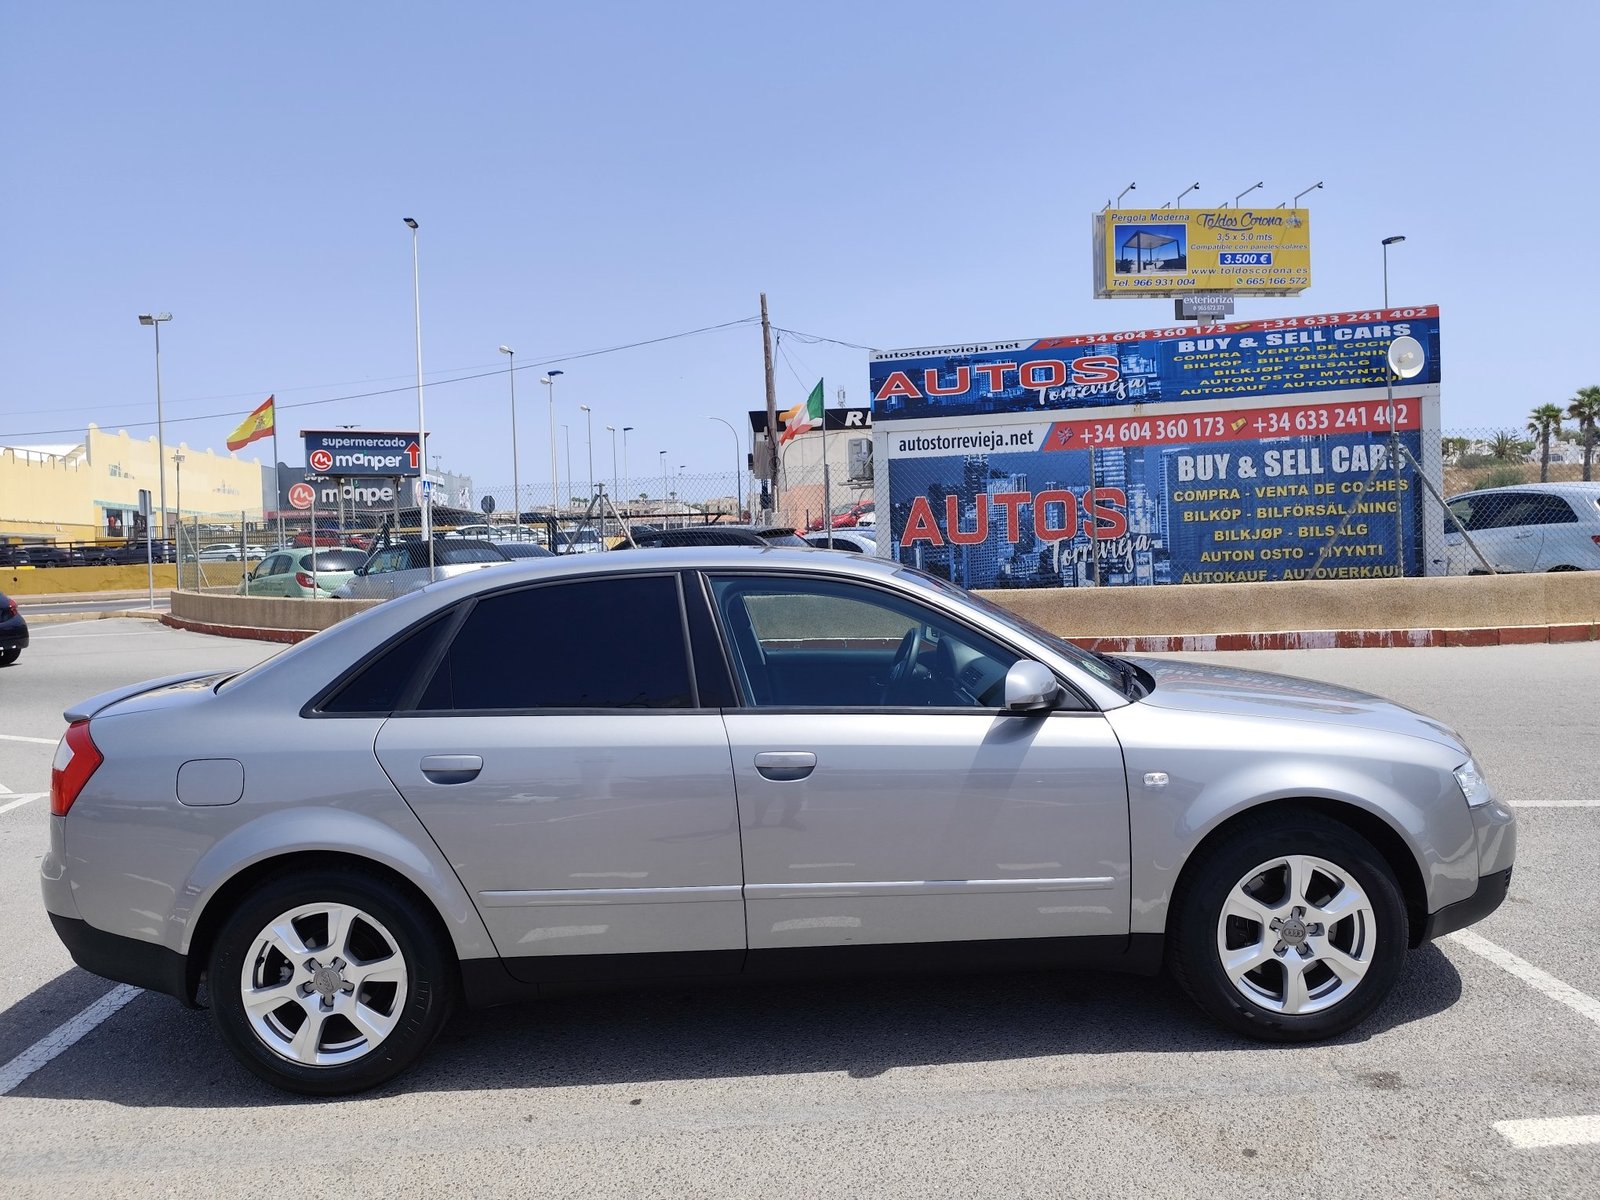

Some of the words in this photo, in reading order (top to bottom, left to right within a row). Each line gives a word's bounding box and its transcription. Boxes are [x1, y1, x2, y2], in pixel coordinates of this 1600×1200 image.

[1111, 213, 1147, 223] Pergola
[1150, 213, 1190, 222] Moderna
[1196, 213, 1238, 229] Toldos
[1240, 212, 1283, 227] Corona
[1217, 233, 1230, 241] 3,5
[1250, 243, 1278, 251] paneles
[1224, 253, 1257, 264] 3.500
[1260, 253, 1269, 264] €
[1191, 266, 1308, 275] www.toldoscorona.es
[1176, 278, 1196, 286] 004
[1269, 277, 1286, 285] 166
[1289, 277, 1308, 285] 572
[1183, 295, 1234, 304] exterioriza
[875, 341, 1020, 360] autostorrevieja.net
[1070, 334, 1107, 344] +34
[1113, 330, 1147, 341] 604
[1152, 327, 1187, 338] 360
[1193, 325, 1227, 335] 173
[1258, 317, 1299, 330] +34
[1304, 315, 1340, 326] 633
[1347, 311, 1381, 322] 241
[1389, 308, 1428, 318] 402
[1178, 337, 1231, 353] BUY
[1238, 335, 1259, 347] &
[1266, 329, 1326, 346] SELL
[1334, 323, 1411, 341] CARS
[1173, 351, 1241, 362] COMPRA
[1256, 345, 1311, 355] VENTA
[1316, 343, 1337, 351] DE
[1343, 340, 1391, 349] COCH
[1184, 357, 1242, 370] BILKÖP
[1257, 349, 1388, 365] BILFÖRSÄLJNIN
[1214, 365, 1283, 376] BILKJØP
[1299, 359, 1370, 370] BILSALG
[874, 355, 1120, 401] AUTOS
[1200, 375, 1255, 386] AUTON
[1260, 371, 1304, 381] OSTO
[1320, 367, 1386, 377] MYYNTI
[1033, 376, 1147, 405] Torrevieja
[1180, 384, 1267, 396] AUTOKAUF
[1283, 375, 1404, 389] AUTOVERKAU
[899, 429, 1034, 452] autostorrevieja.net
[1080, 424, 1114, 444] +34
[1119, 421, 1152, 441] 604
[1155, 419, 1188, 440] 360
[1193, 416, 1225, 437] 173
[1253, 411, 1291, 433] +34
[1295, 409, 1329, 430] 633
[1334, 406, 1367, 428] 241
[1373, 403, 1408, 425] 402
[321, 437, 406, 449] supermercado
[335, 453, 402, 471] manper
[1178, 453, 1231, 482] BUY
[1237, 455, 1257, 478] &
[1264, 446, 1324, 480] SELL
[1331, 442, 1406, 473] CARS
[321, 485, 402, 507] manpe
[1173, 489, 1241, 502] COMPRA
[1255, 484, 1310, 498] VENTA
[1314, 483, 1336, 495] DE
[1341, 479, 1409, 493] COCHES
[900, 486, 1128, 548] AUTOS
[1184, 507, 1242, 522] BILKÖP
[1214, 526, 1283, 542] BILKJØP
[1201, 550, 1255, 562] AUTON
[1260, 547, 1304, 560] OSTO
[1182, 569, 1267, 584] AUTOKAUF
